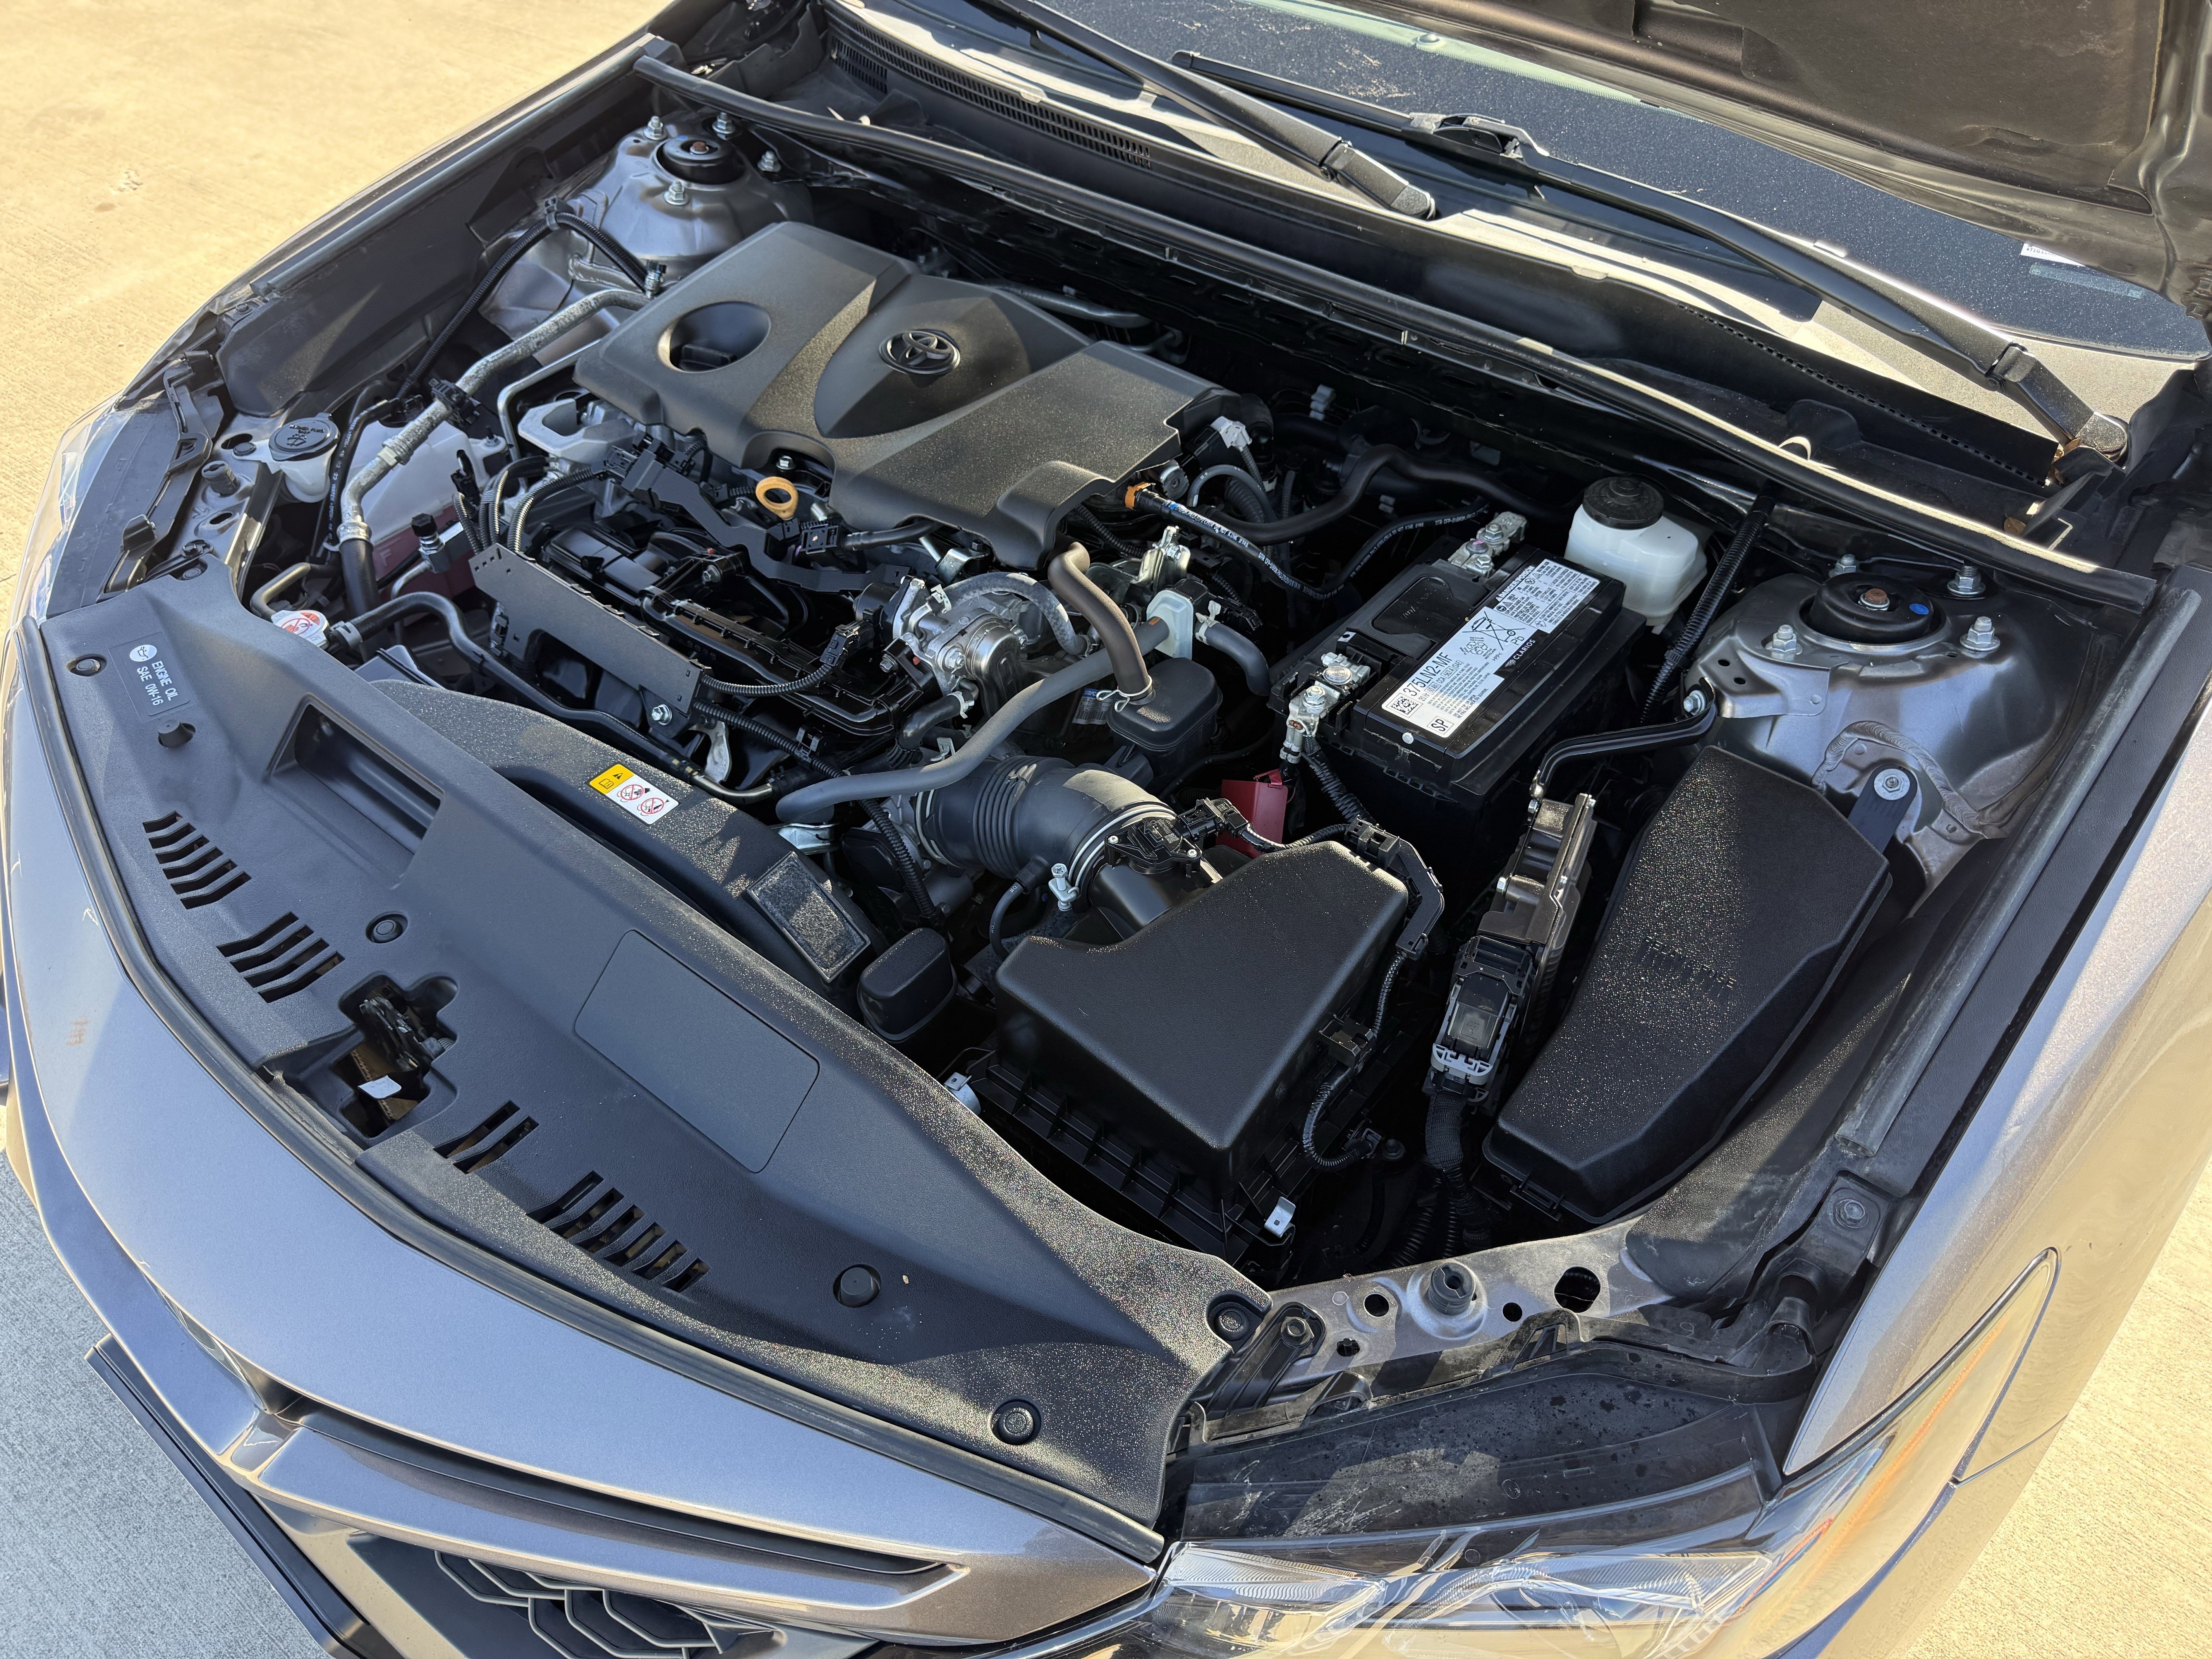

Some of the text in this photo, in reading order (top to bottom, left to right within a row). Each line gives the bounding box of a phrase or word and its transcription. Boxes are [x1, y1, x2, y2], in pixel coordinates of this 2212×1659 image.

[1500, 565, 1535, 598] DANGER/POISON
[1510, 635, 1525, 646] Pb
[1513, 639, 1536, 660] CLARIOS
[137, 666, 164, 706] SAE 0W-16
[152, 661, 178, 701] ENGINE OIL
[1403, 652, 1452, 697] 375LN2-MF
[1431, 719, 1448, 731] SP
